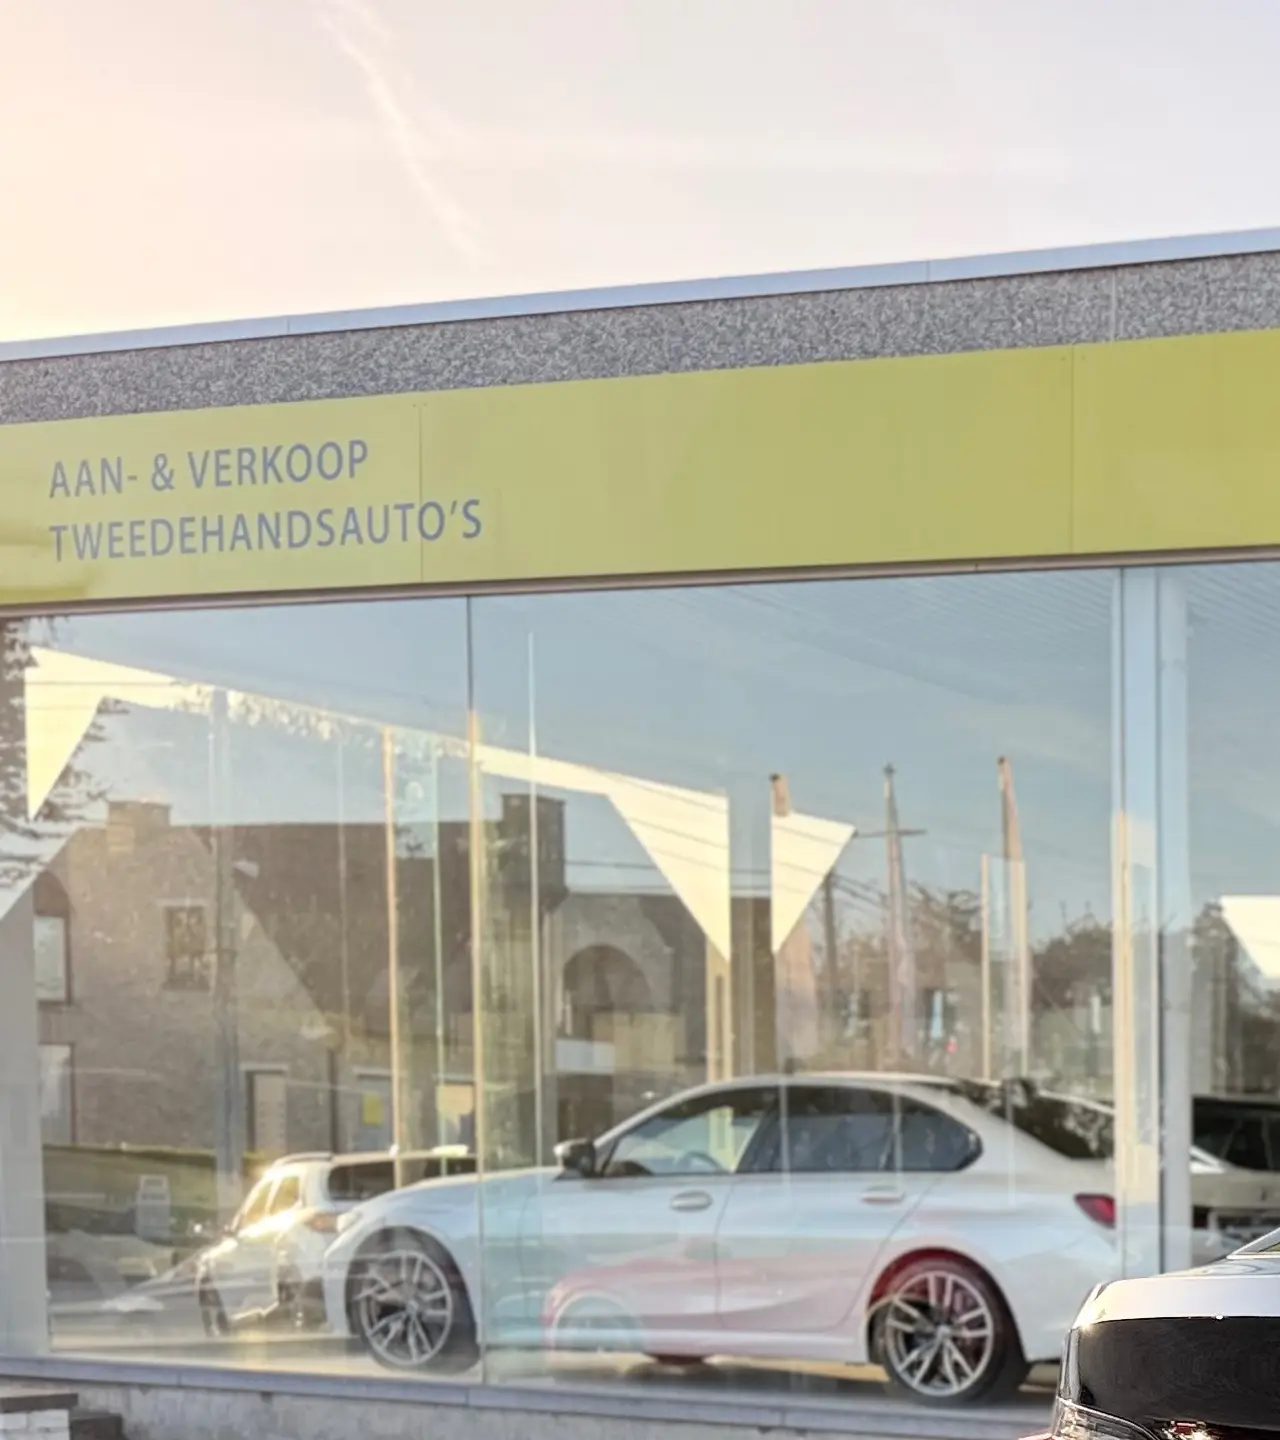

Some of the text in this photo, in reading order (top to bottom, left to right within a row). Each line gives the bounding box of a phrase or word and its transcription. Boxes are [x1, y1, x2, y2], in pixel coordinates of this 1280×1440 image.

[49, 439, 369, 499] AAN- & VERKOOP
[49, 498, 483, 563] TWEEDEHANDSAUTO'S
